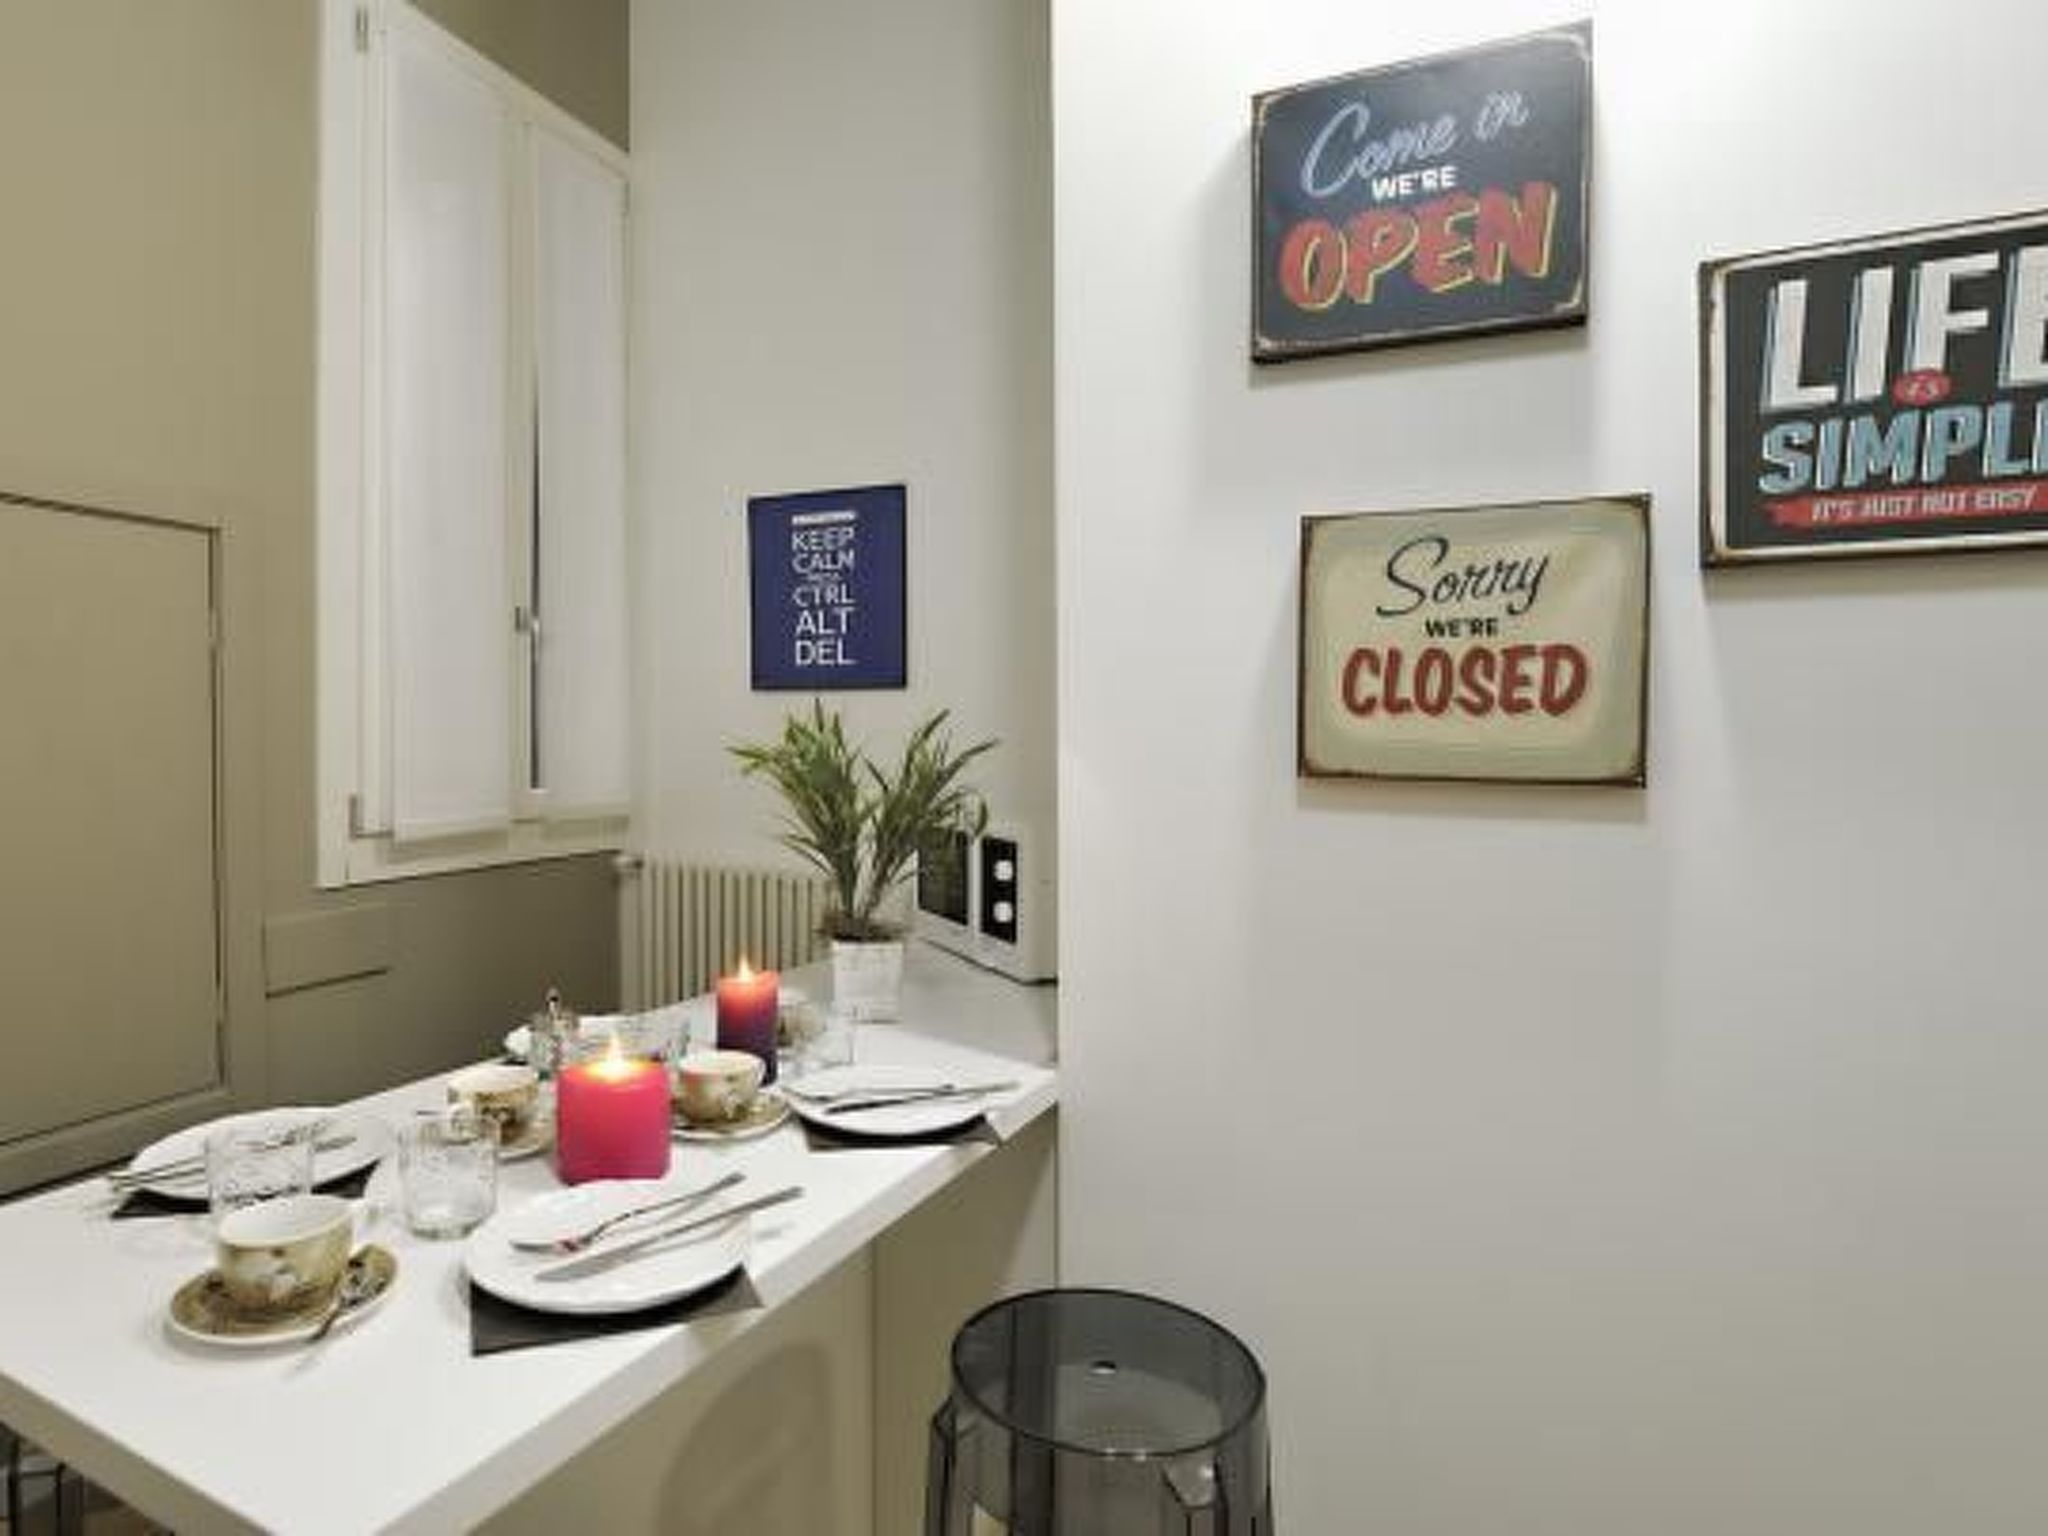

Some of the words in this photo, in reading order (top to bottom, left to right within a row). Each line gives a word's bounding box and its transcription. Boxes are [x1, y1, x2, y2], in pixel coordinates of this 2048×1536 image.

[1302, 99, 1456, 197] Come
[1475, 89, 1529, 140] in
[1370, 166, 1458, 200] WE'RE
[1279, 181, 1558, 312] OPEN
[792, 526, 856, 551] KEEP
[1376, 535, 1550, 617] Sorry
[792, 583, 856, 608] CTRL
[795, 606, 856, 635] ALT
[1425, 616, 1500, 639] WE'RE
[795, 638, 858, 666] DEL
[1341, 643, 1588, 717] CLOSED
